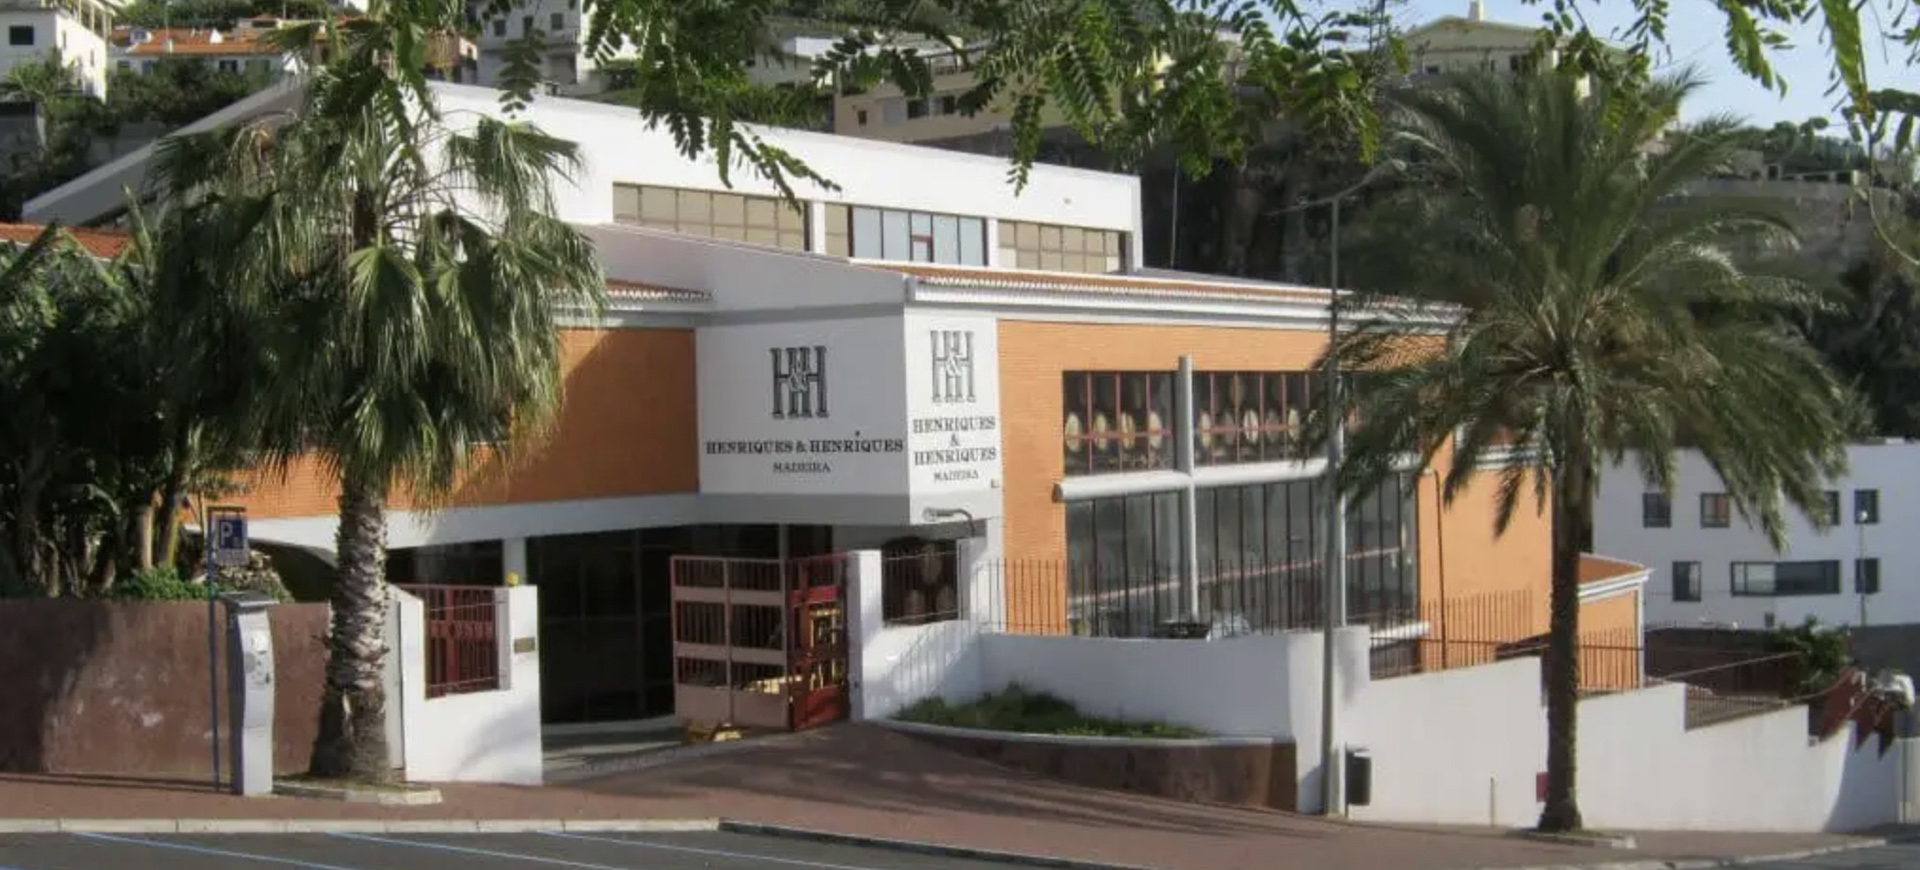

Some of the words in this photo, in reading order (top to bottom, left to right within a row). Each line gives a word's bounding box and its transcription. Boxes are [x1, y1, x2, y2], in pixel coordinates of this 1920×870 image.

[912, 416, 996, 433] HENRIQUES
[706, 441, 793, 454] HENRIQUES
[796, 440, 807, 453] &
[810, 439, 903, 453] HENRIQUES
[949, 433, 960, 447] &
[914, 447, 997, 465] HENRIQUES
[773, 462, 831, 473] MADEIRA
[933, 470, 979, 482] MADEIRA
[220, 521, 233, 546] P
